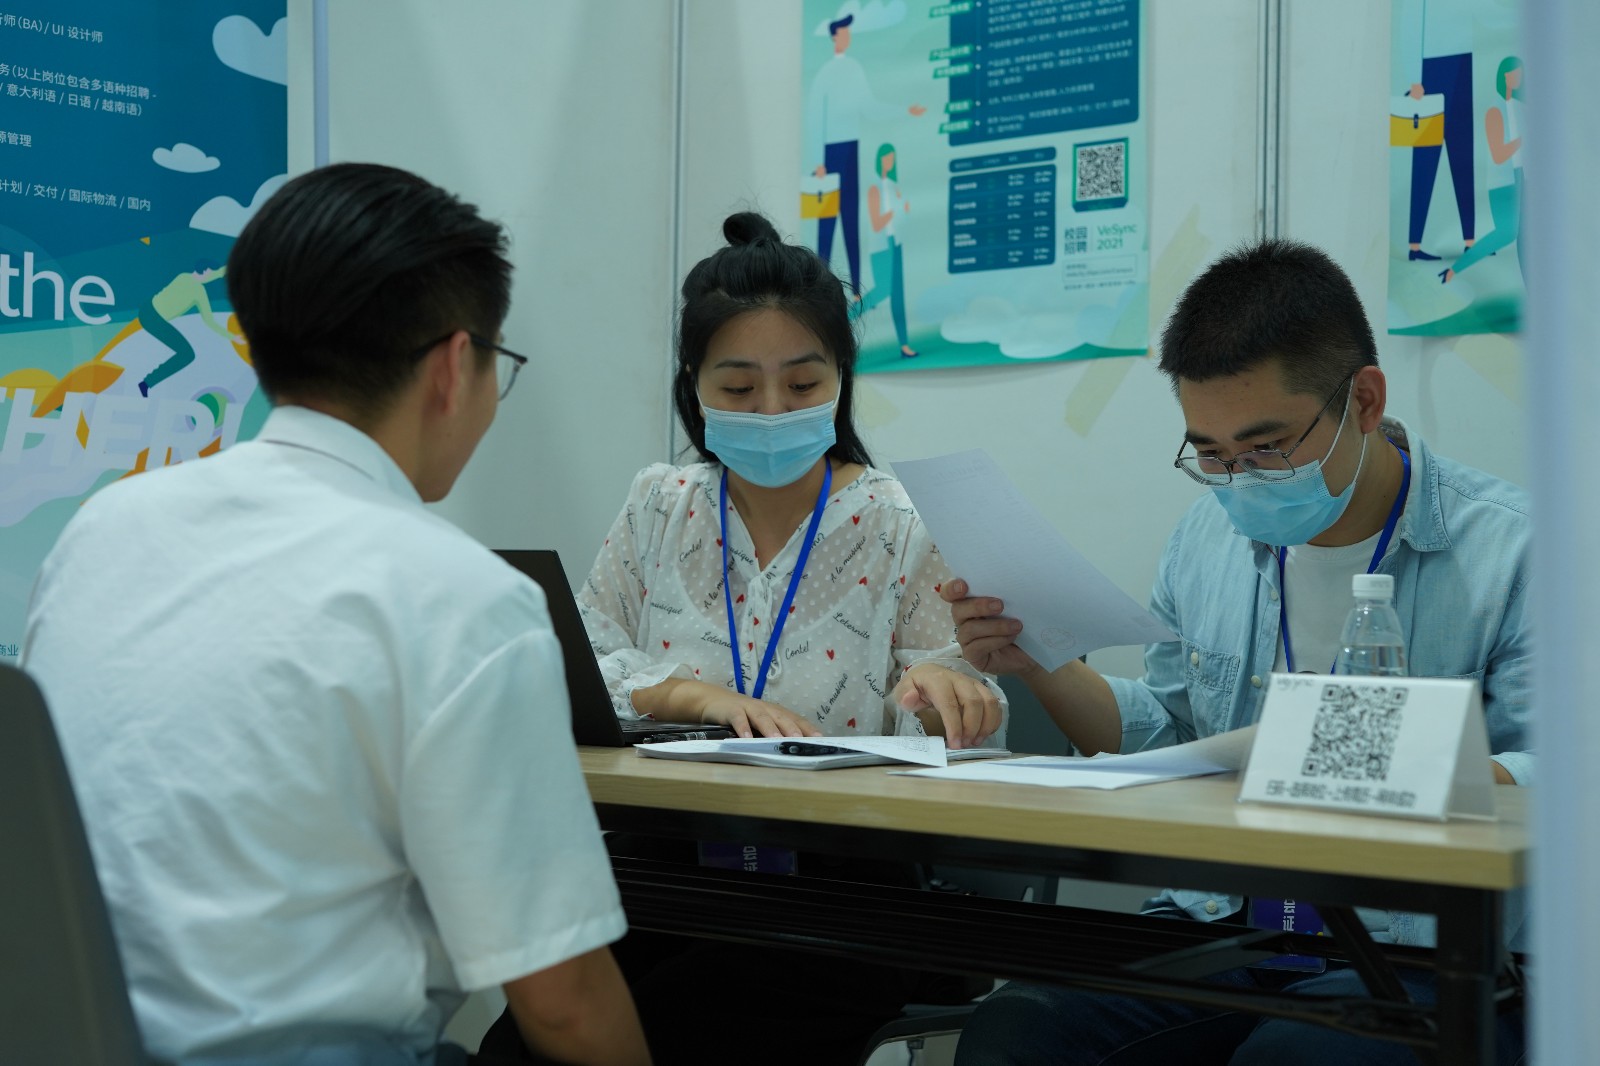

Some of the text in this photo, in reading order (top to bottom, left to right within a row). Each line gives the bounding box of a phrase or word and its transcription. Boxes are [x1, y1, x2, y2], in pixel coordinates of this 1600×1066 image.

[52, 24, 64, 36] UI
[67, 26, 103, 43] 设计师
[6, 83, 56, 103] 意大利语
[68, 93, 91, 109] 日语
[33, 184, 58, 199] 交付
[127, 197, 151, 212] 国内
[1097, 238, 1124, 251] 2021
[0, 251, 116, 325] the
[843, 535, 868, 565] musique
[902, 592, 922, 626] Conte!
[785, 640, 809, 660] Conte!
[829, 672, 849, 706] musique
